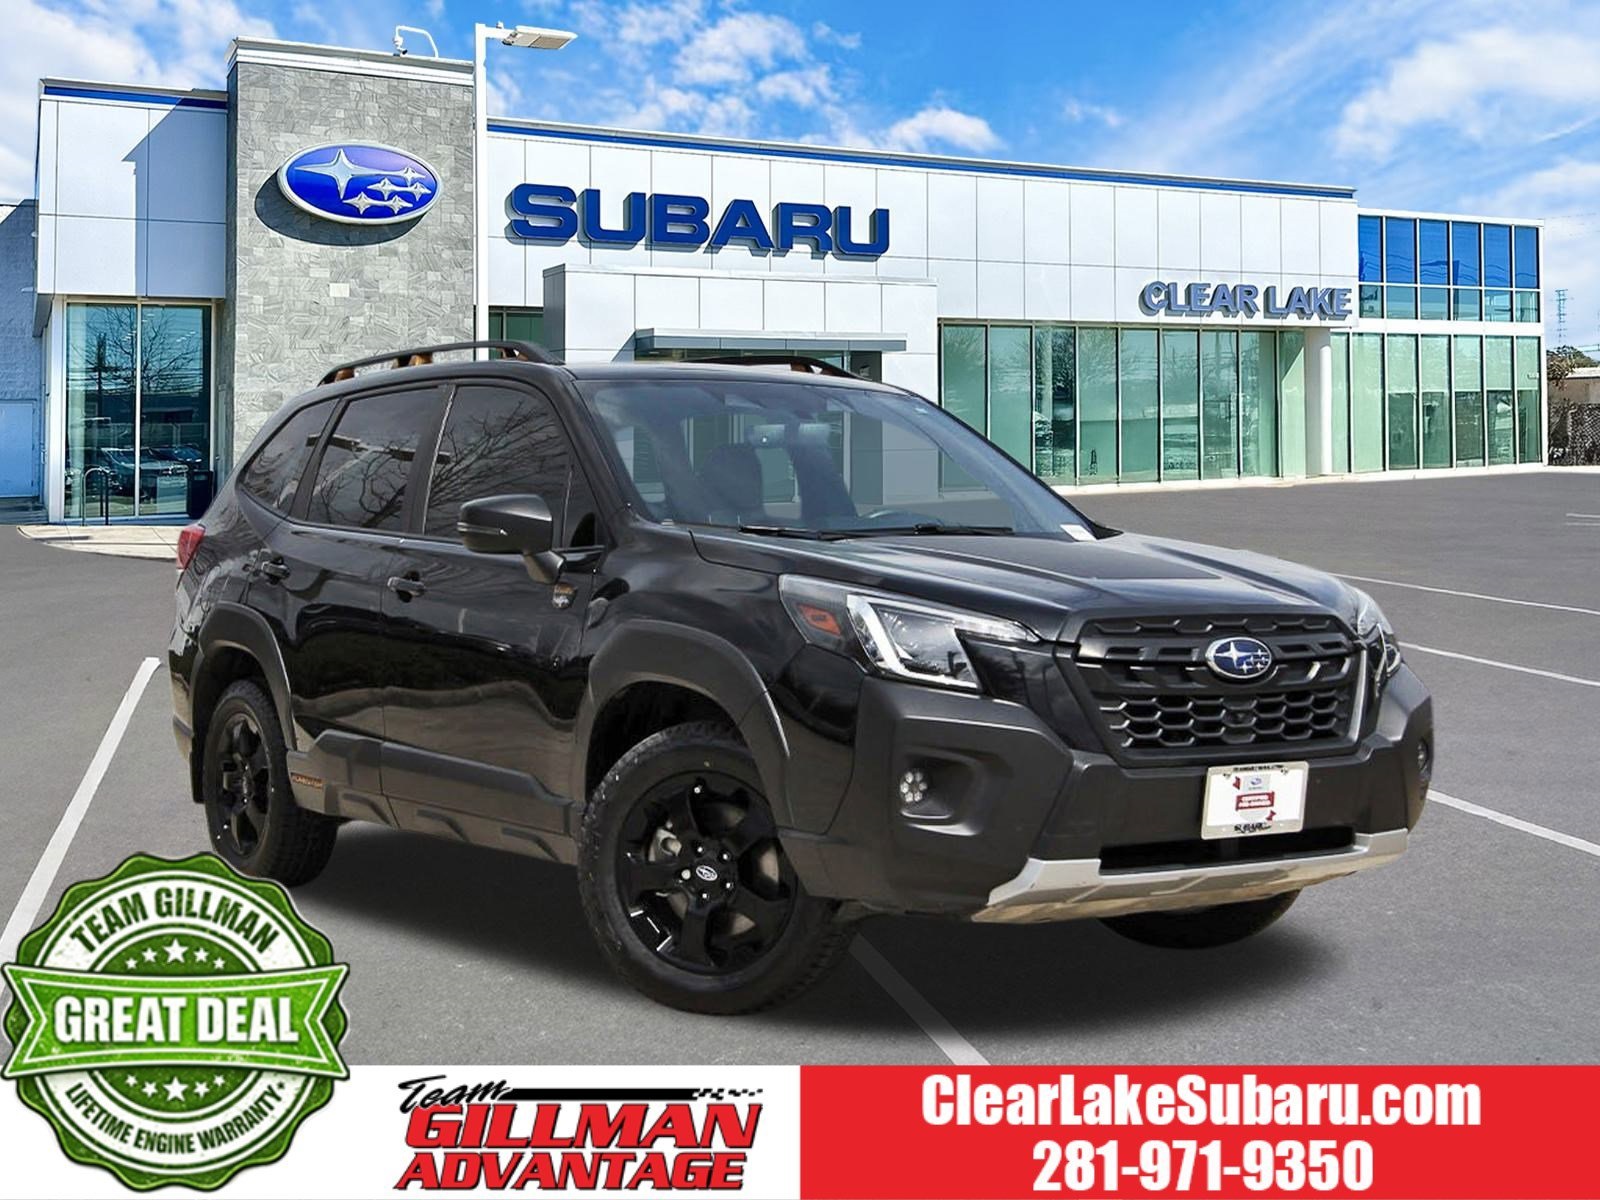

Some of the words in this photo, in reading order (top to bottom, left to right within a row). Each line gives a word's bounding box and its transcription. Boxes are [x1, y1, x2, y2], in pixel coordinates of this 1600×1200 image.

[505, 183, 890, 260] SUBARU
[1139, 281, 1260, 318] CLEAR
[1264, 286, 1352, 320] LAKE
